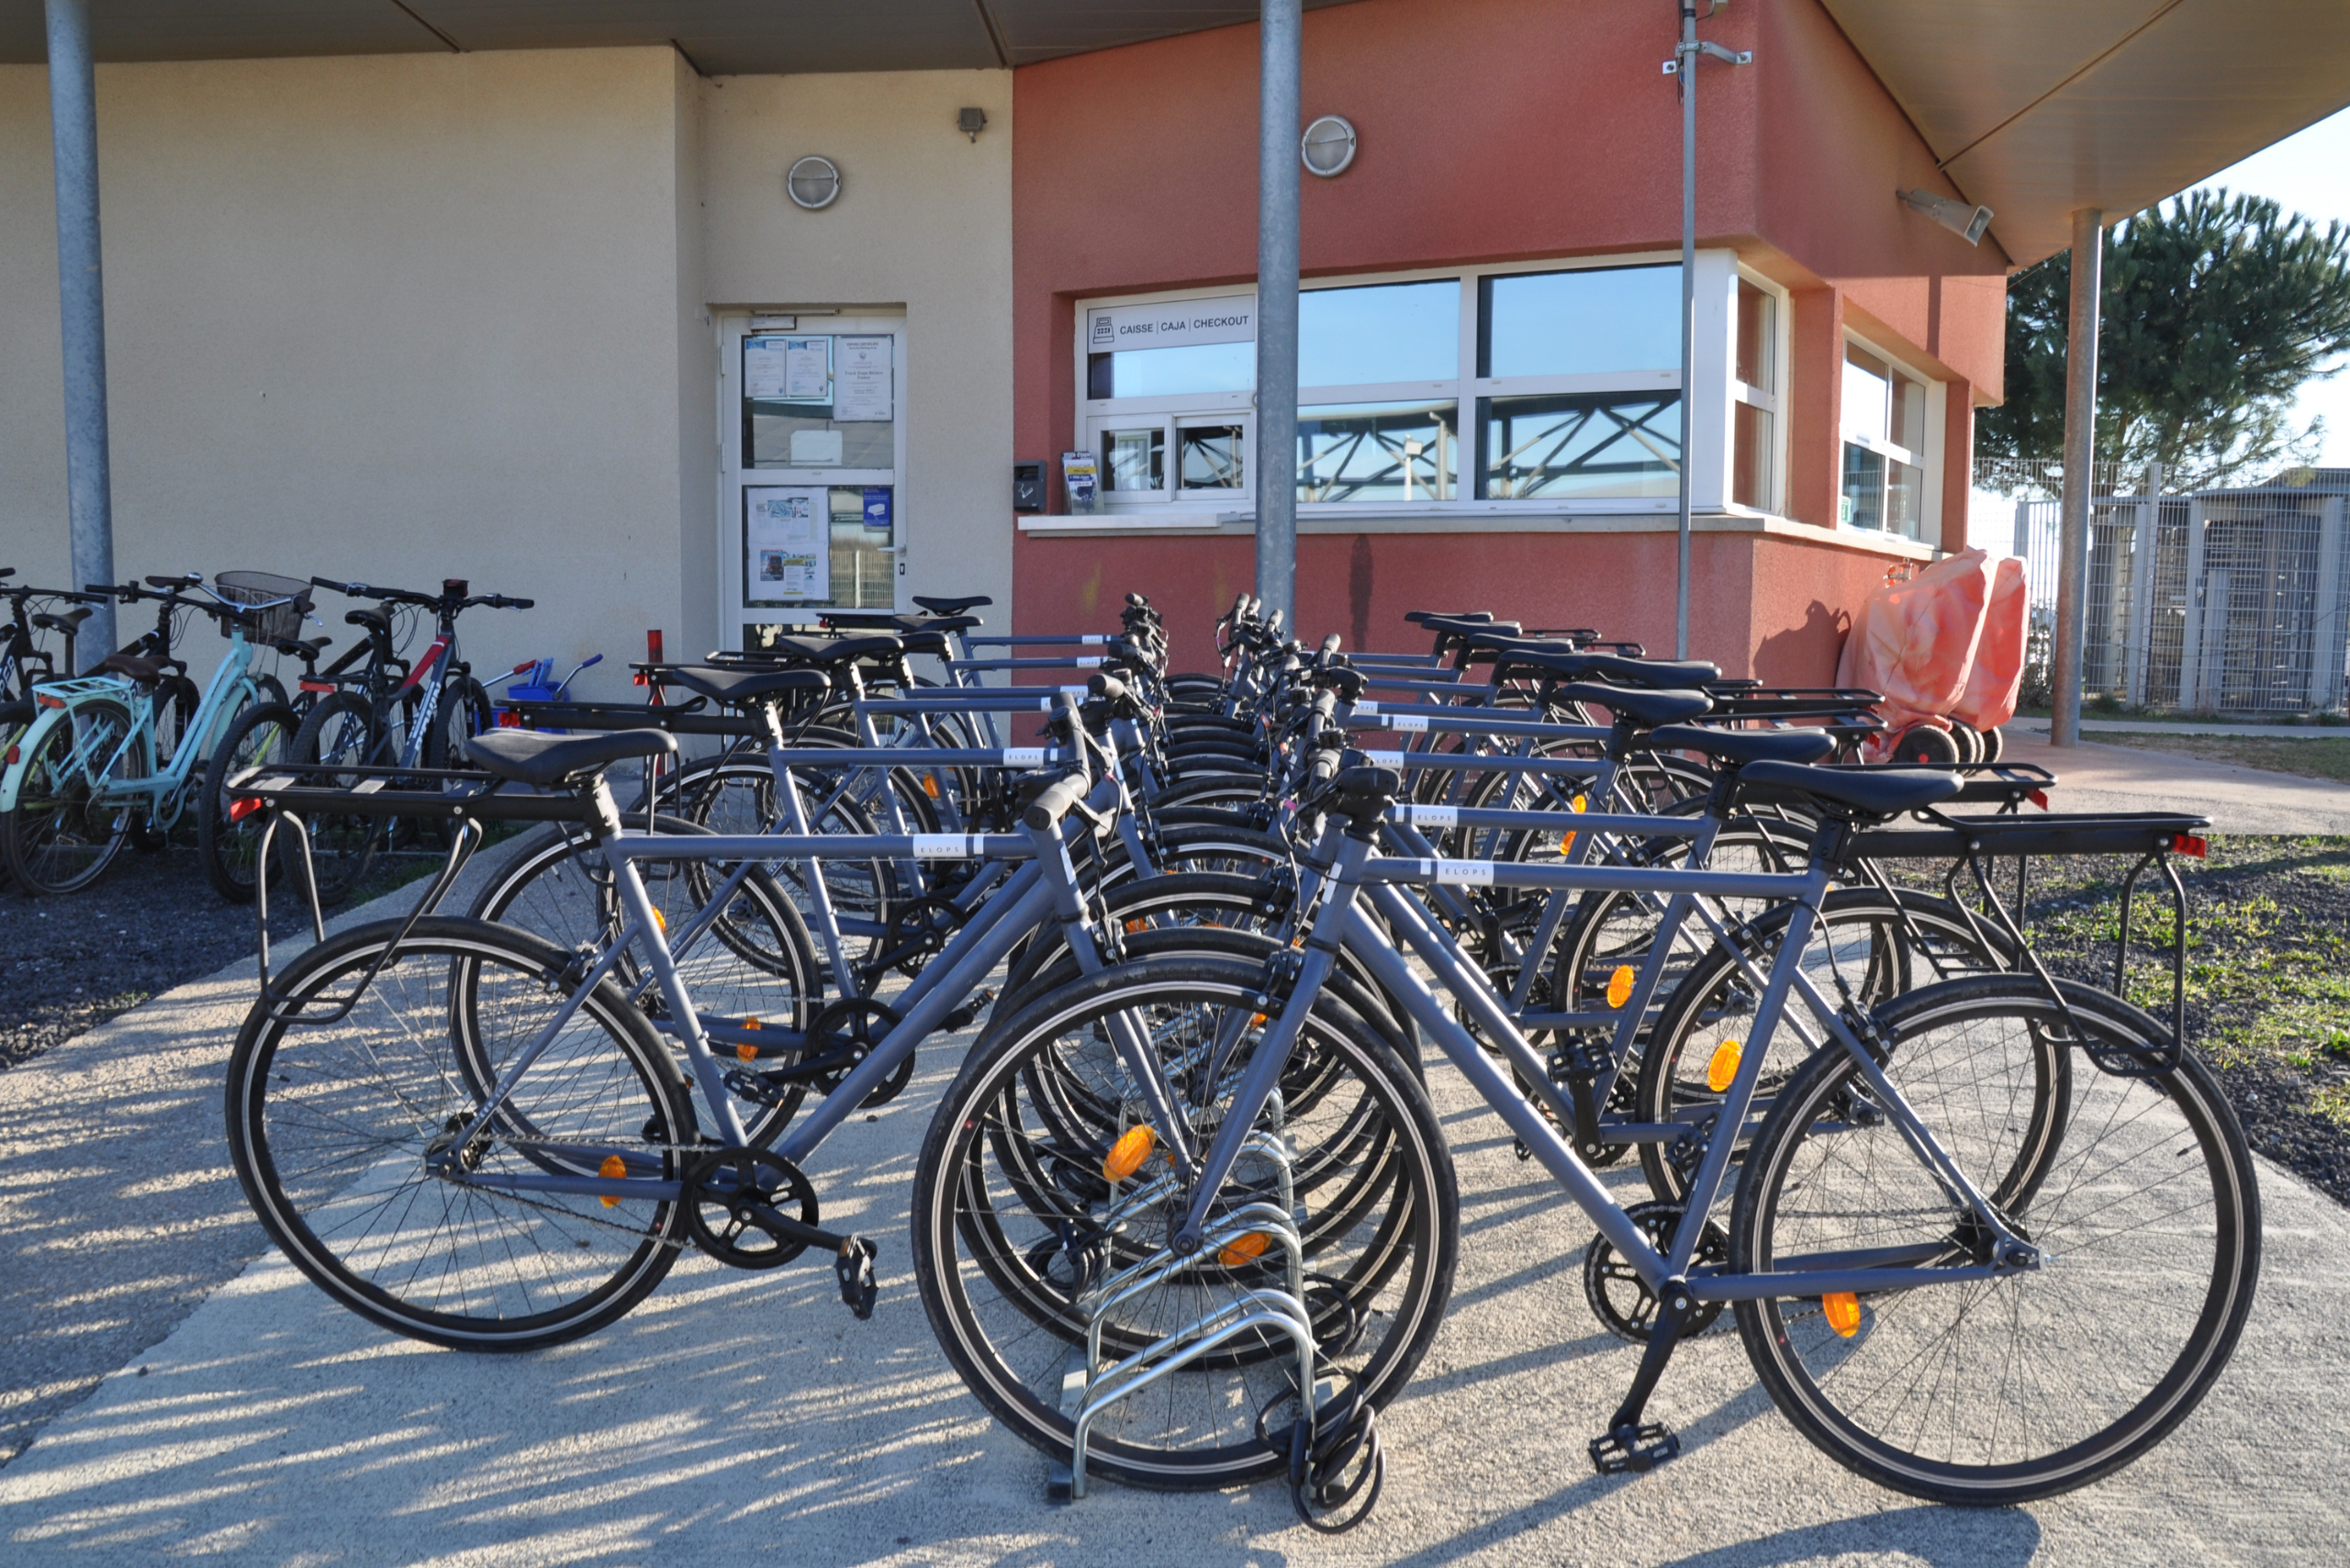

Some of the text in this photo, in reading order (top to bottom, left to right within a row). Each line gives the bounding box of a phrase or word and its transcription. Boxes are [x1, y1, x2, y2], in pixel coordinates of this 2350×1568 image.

[1119, 315, 1249, 335] CAISSE CAJA CHECKOUT
[1445, 868, 1486, 876] ELOPS
